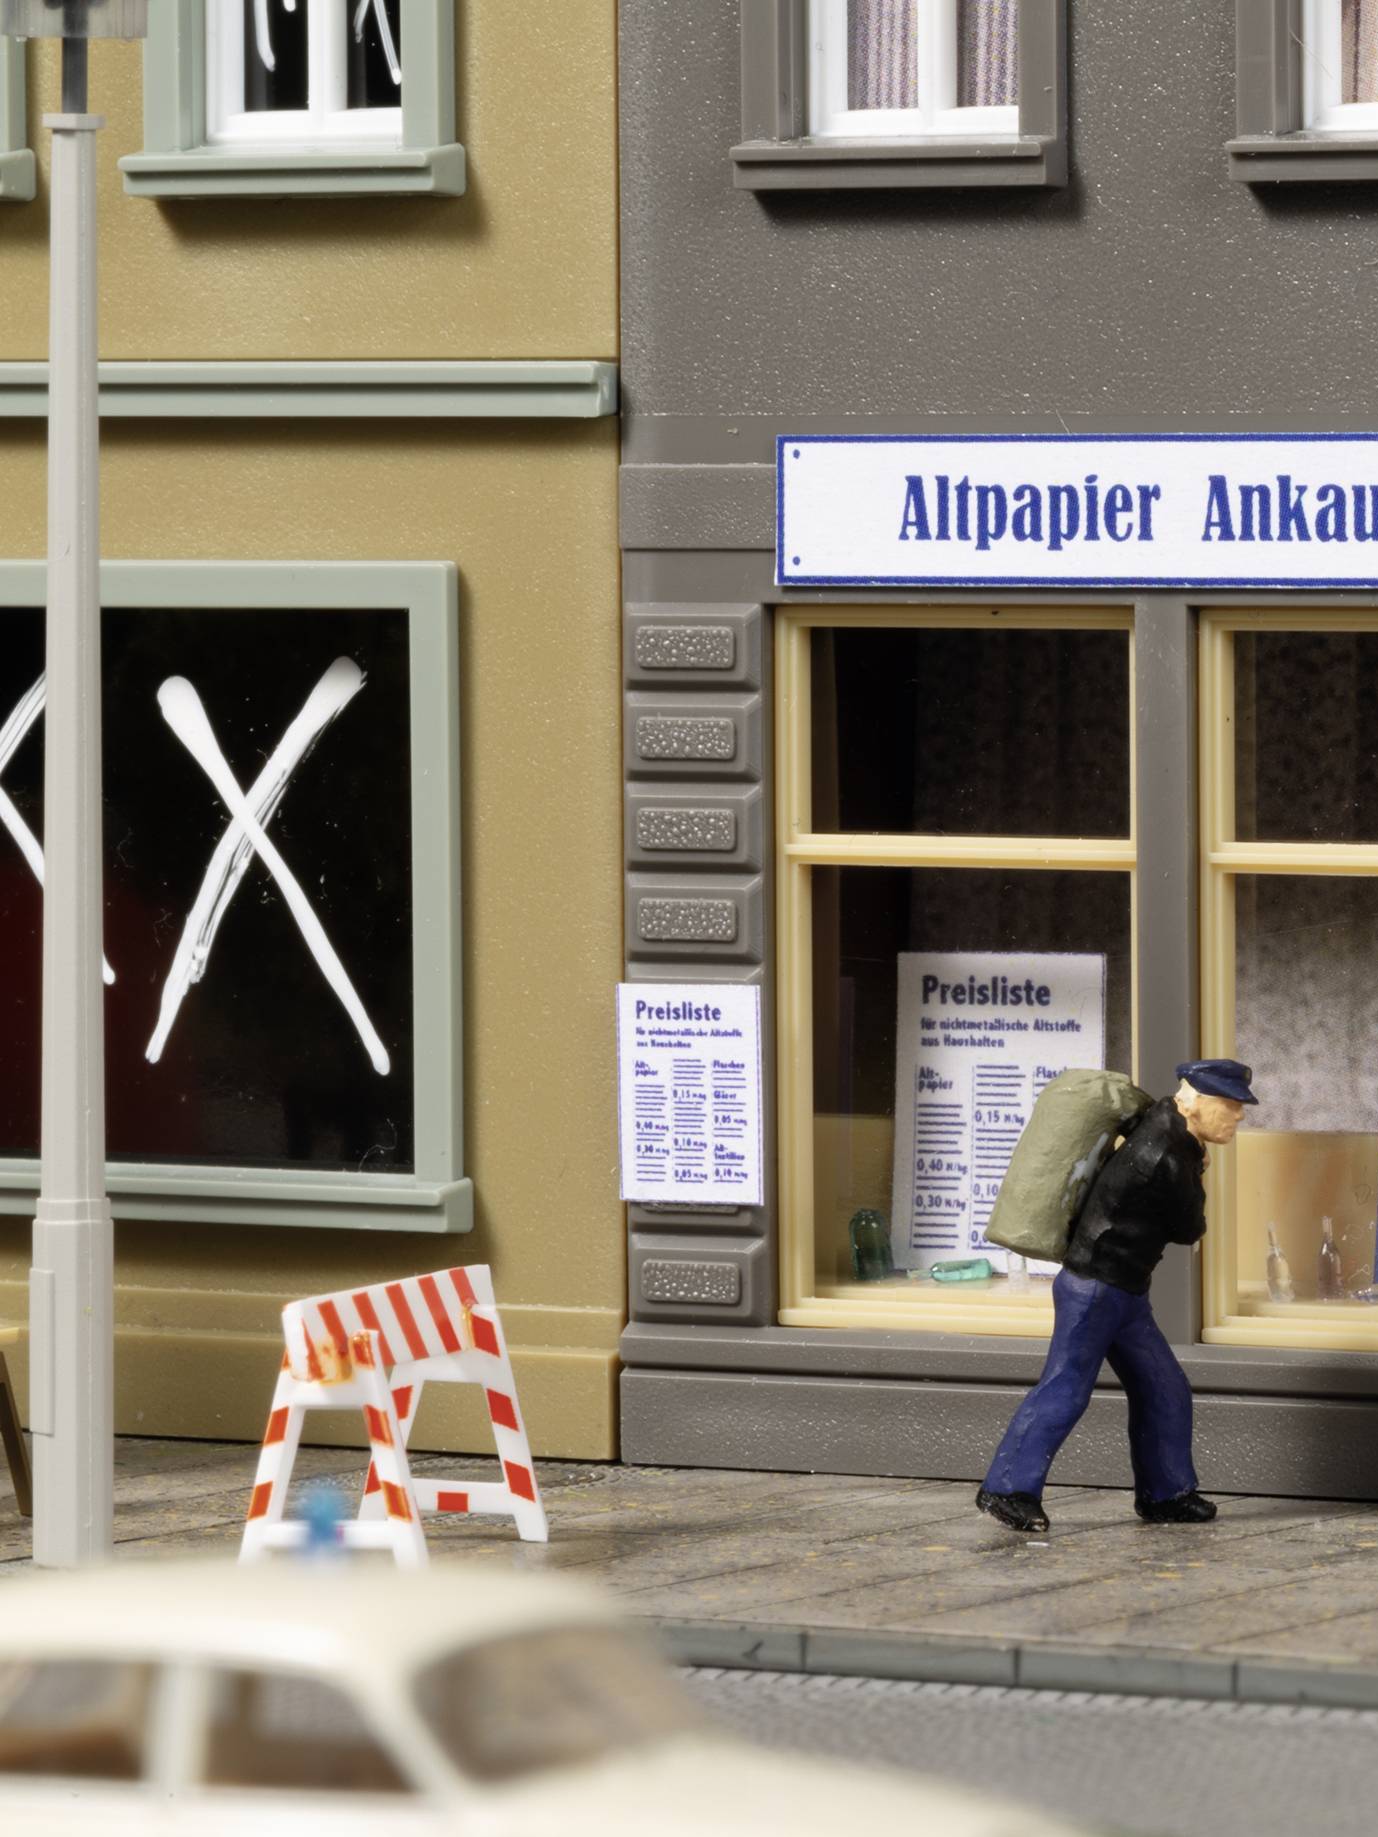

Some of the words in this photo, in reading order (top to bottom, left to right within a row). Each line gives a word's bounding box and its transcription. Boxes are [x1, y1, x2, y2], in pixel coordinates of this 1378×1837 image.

[898, 474, 1163, 551] Altpapier
[921, 974, 1052, 1007] Preisliste
[635, 1000, 722, 1021] Preisliste
